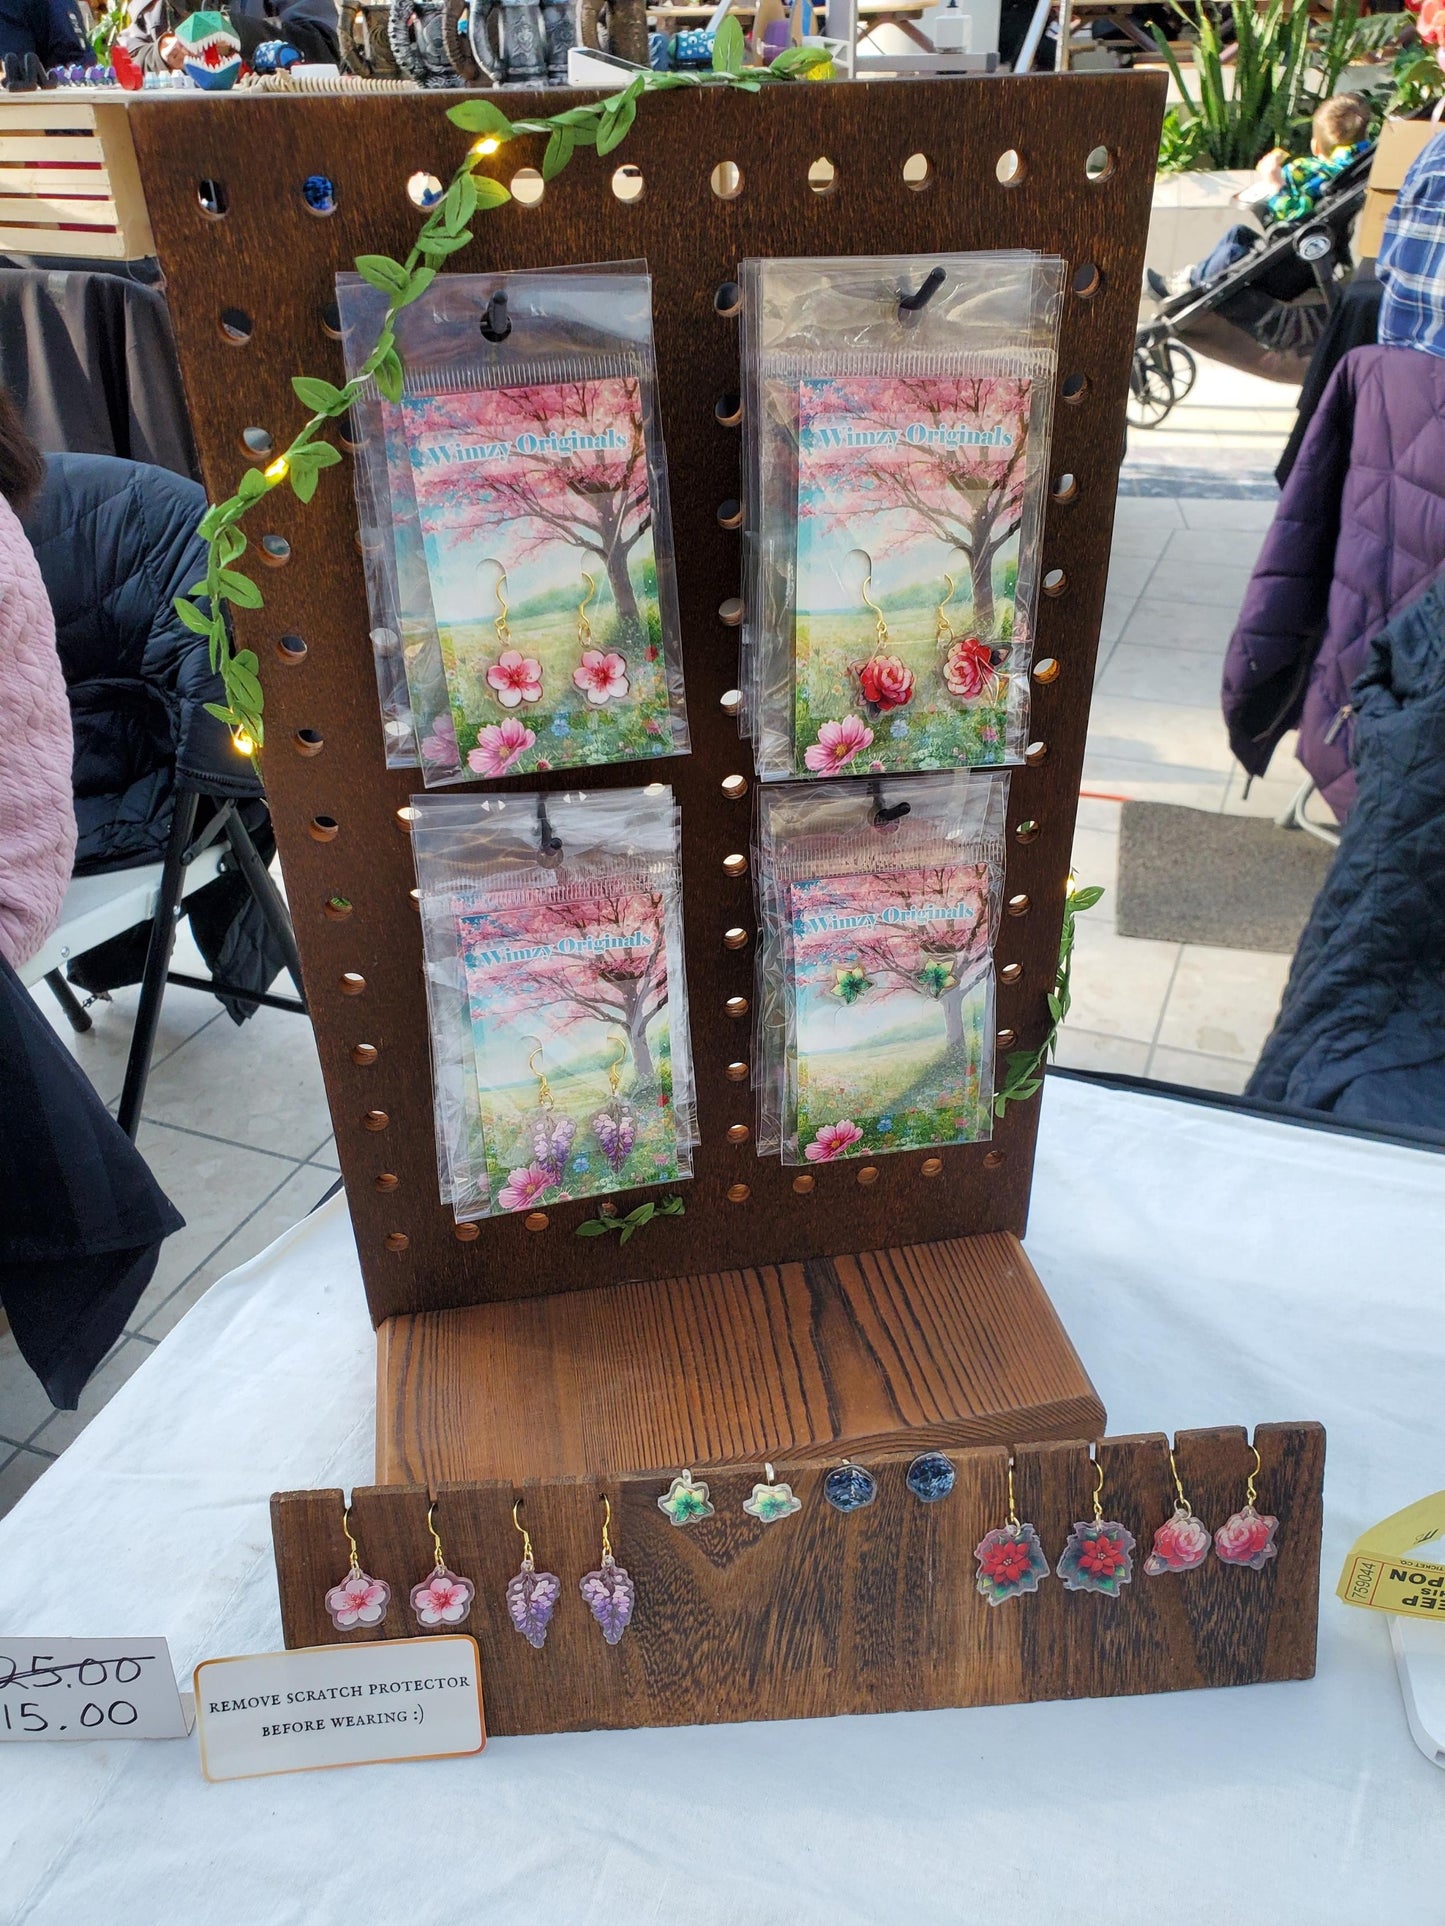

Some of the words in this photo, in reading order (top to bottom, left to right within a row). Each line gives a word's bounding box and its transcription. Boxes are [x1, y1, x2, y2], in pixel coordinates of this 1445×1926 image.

[427, 440, 513, 466] Wimzy
[516, 428, 628, 457] Originals
[818, 425, 902, 450] Wimzy
[906, 422, 1013, 451] Originals
[808, 913, 878, 934] Wimzy
[881, 902, 974, 926] Originals
[479, 943, 554, 967] Wimzy
[558, 931, 652, 956] Originals
[1351, 1562, 1376, 1599] 759044
[0, 1655, 142, 1690] 25.00
[209, 1694, 281, 1714] REMOVE
[286, 1685, 363, 1704] SCRATCH
[369, 1676, 471, 1695] PROTECTOR
[3, 1700, 138, 1732] 15.00
[262, 1719, 326, 1737] BEFORE
[330, 1711, 408, 1728] WEARING
